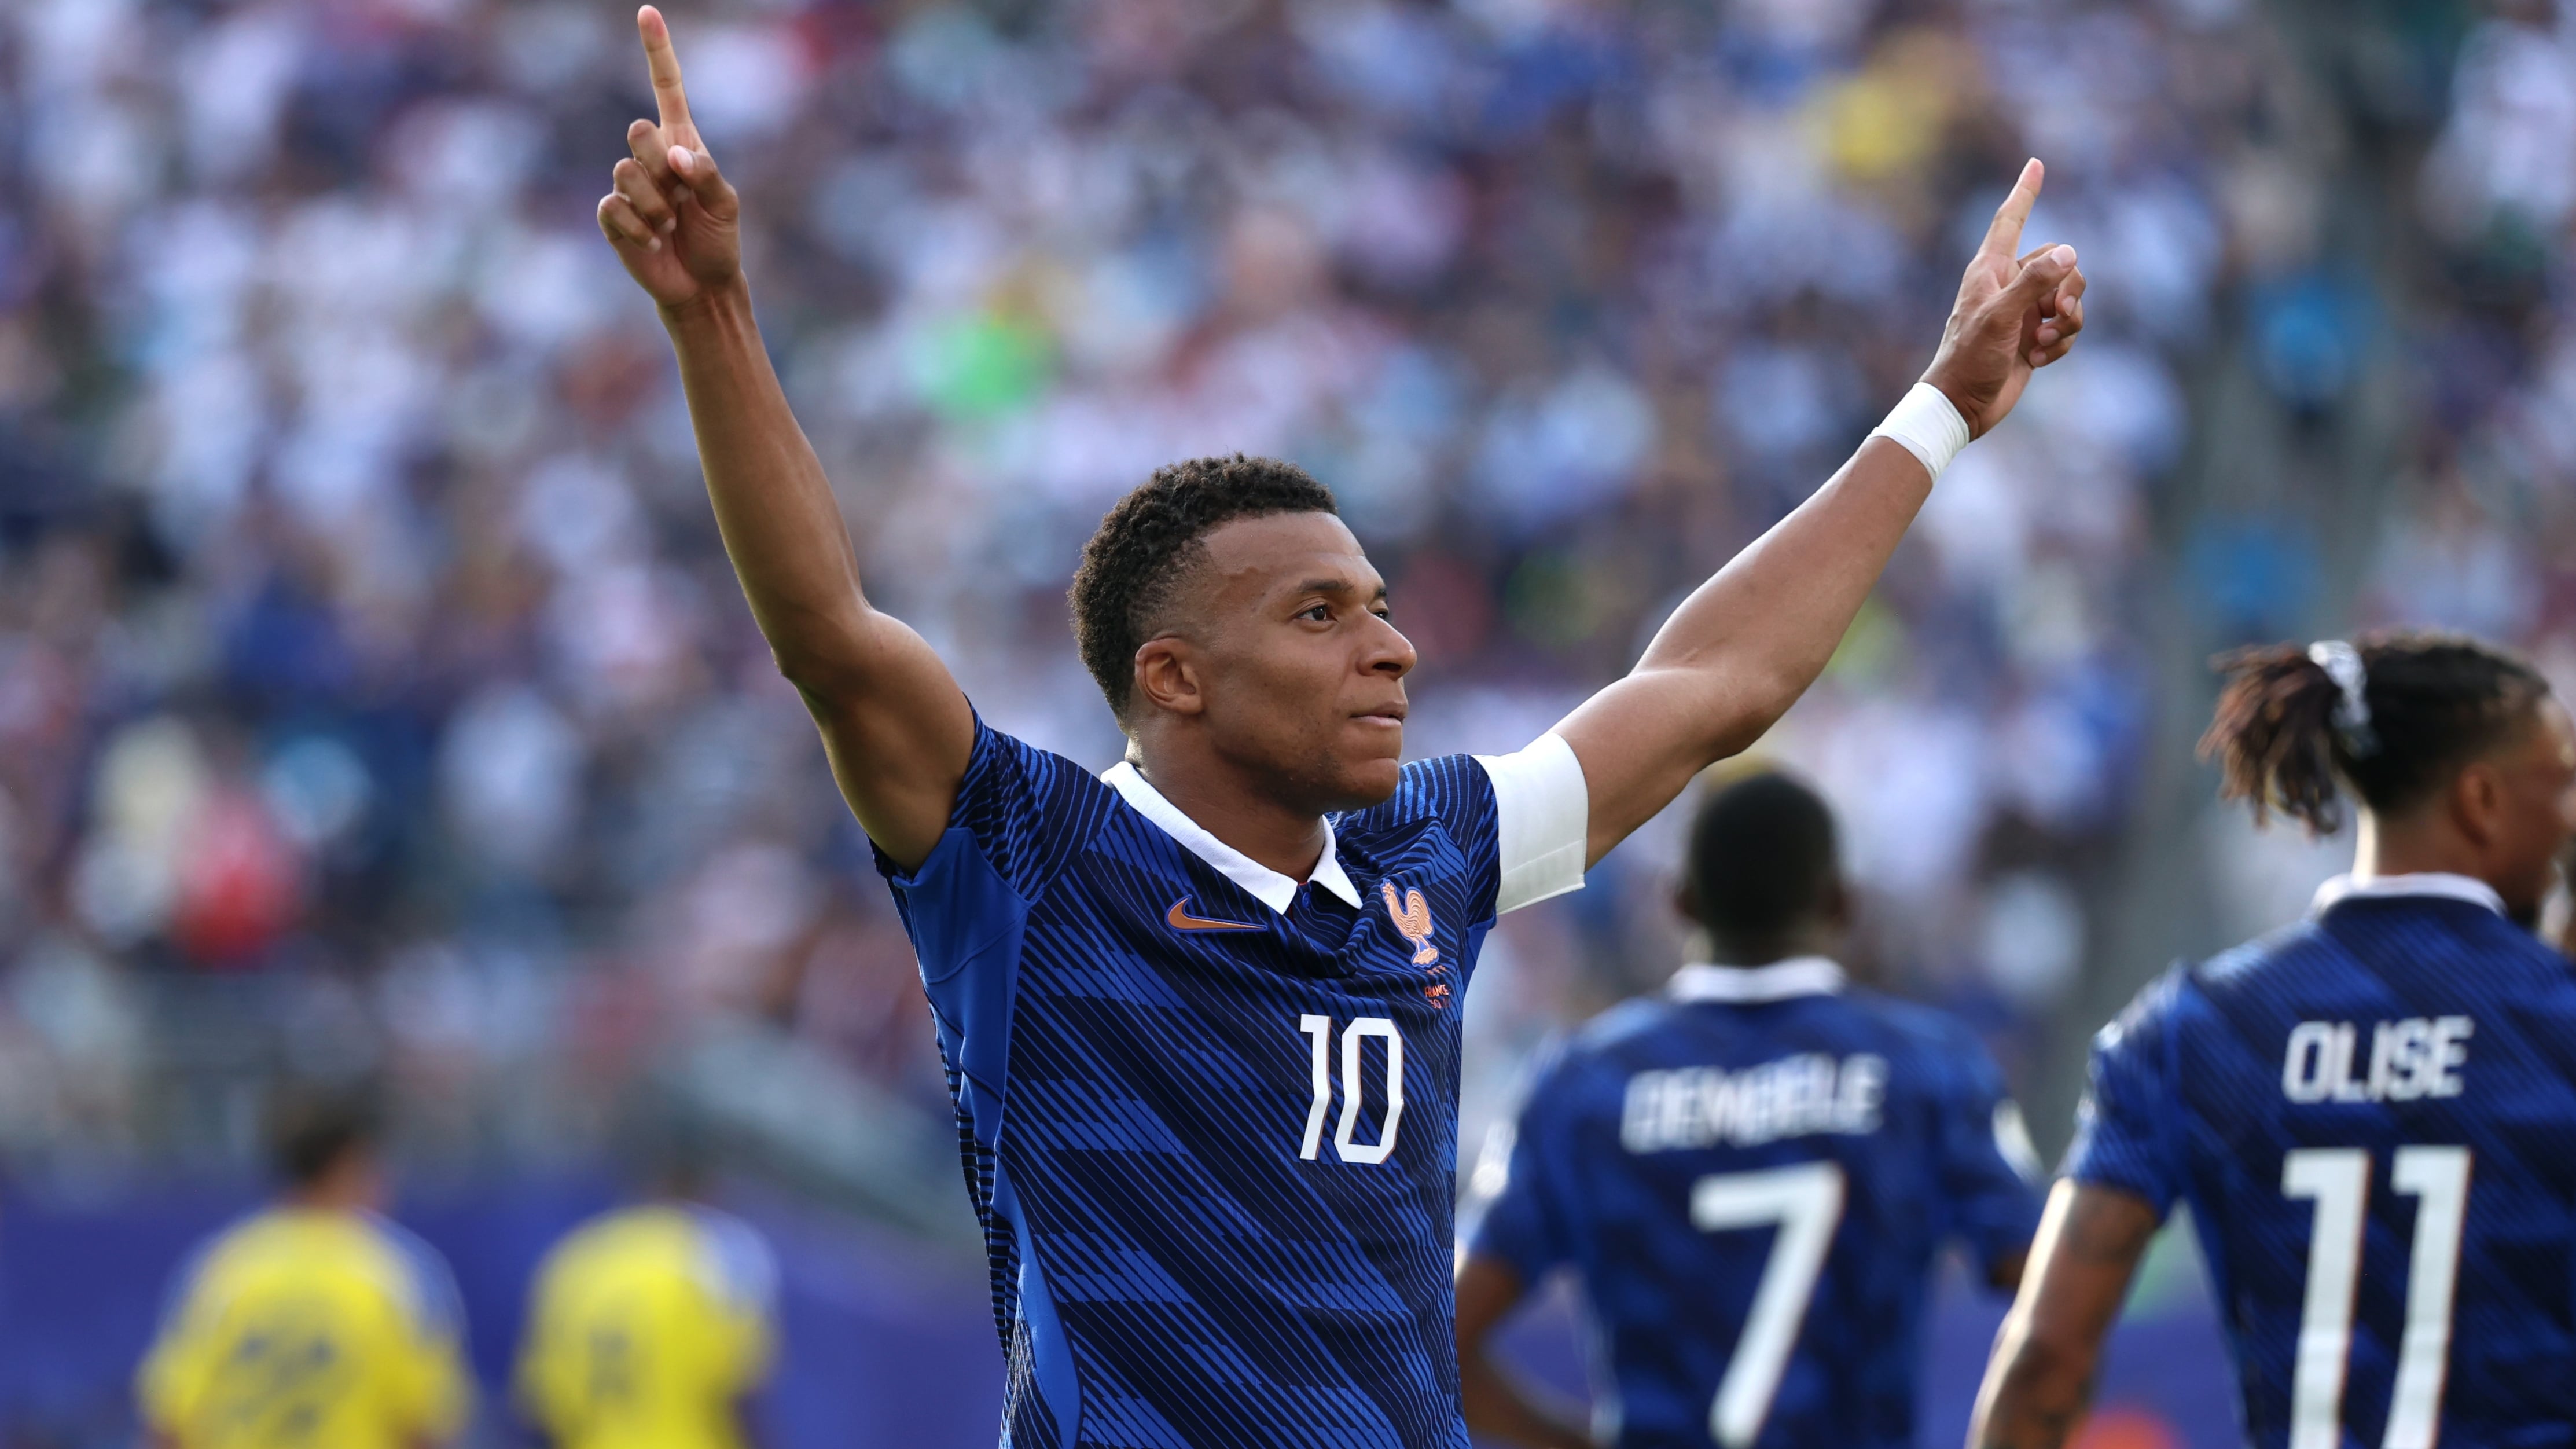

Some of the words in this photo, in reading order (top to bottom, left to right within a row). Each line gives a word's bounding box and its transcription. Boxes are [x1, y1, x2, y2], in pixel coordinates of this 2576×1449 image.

[1425, 984, 1449, 997] FRANCE
[2282, 1016, 2473, 1103] OLISE
[1299, 1014, 1404, 1164] 10
[1691, 1162, 1845, 1448] 7
[2281, 1146, 2472, 1449] 11
